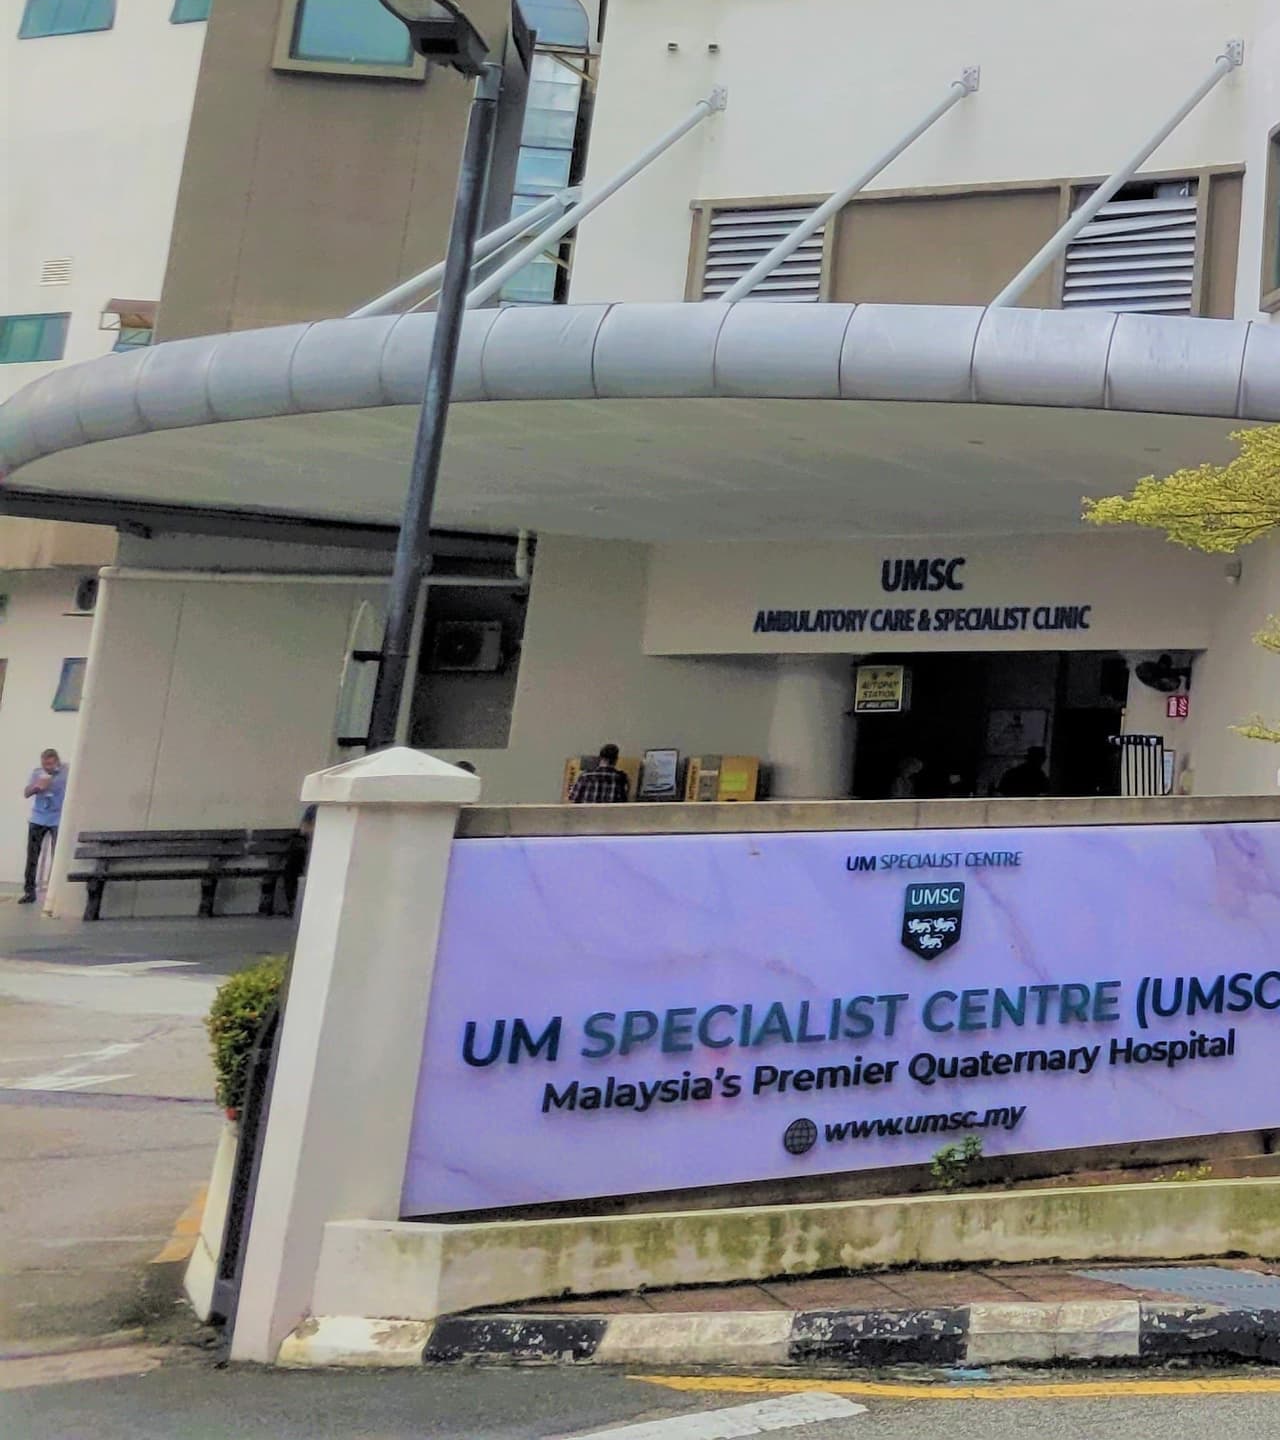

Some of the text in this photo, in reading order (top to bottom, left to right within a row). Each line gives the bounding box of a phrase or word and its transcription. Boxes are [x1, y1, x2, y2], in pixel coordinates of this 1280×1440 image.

[881, 557, 966, 592] UMSC
[753, 606, 1092, 634] AMBULATORY CARE & SPECIALIST CLINIC
[847, 850, 1024, 871] UM SPECIALIST CENTRE
[911, 887, 961, 905] UMSC
[462, 1015, 563, 1067] UM
[581, 992, 909, 1059] SPECIALIST
[922, 980, 1122, 1033] CENTRE
[541, 1027, 1236, 1113] Malaysia's Premier Quaternary Hospital
[824, 1103, 1027, 1143] www.umsc.my
